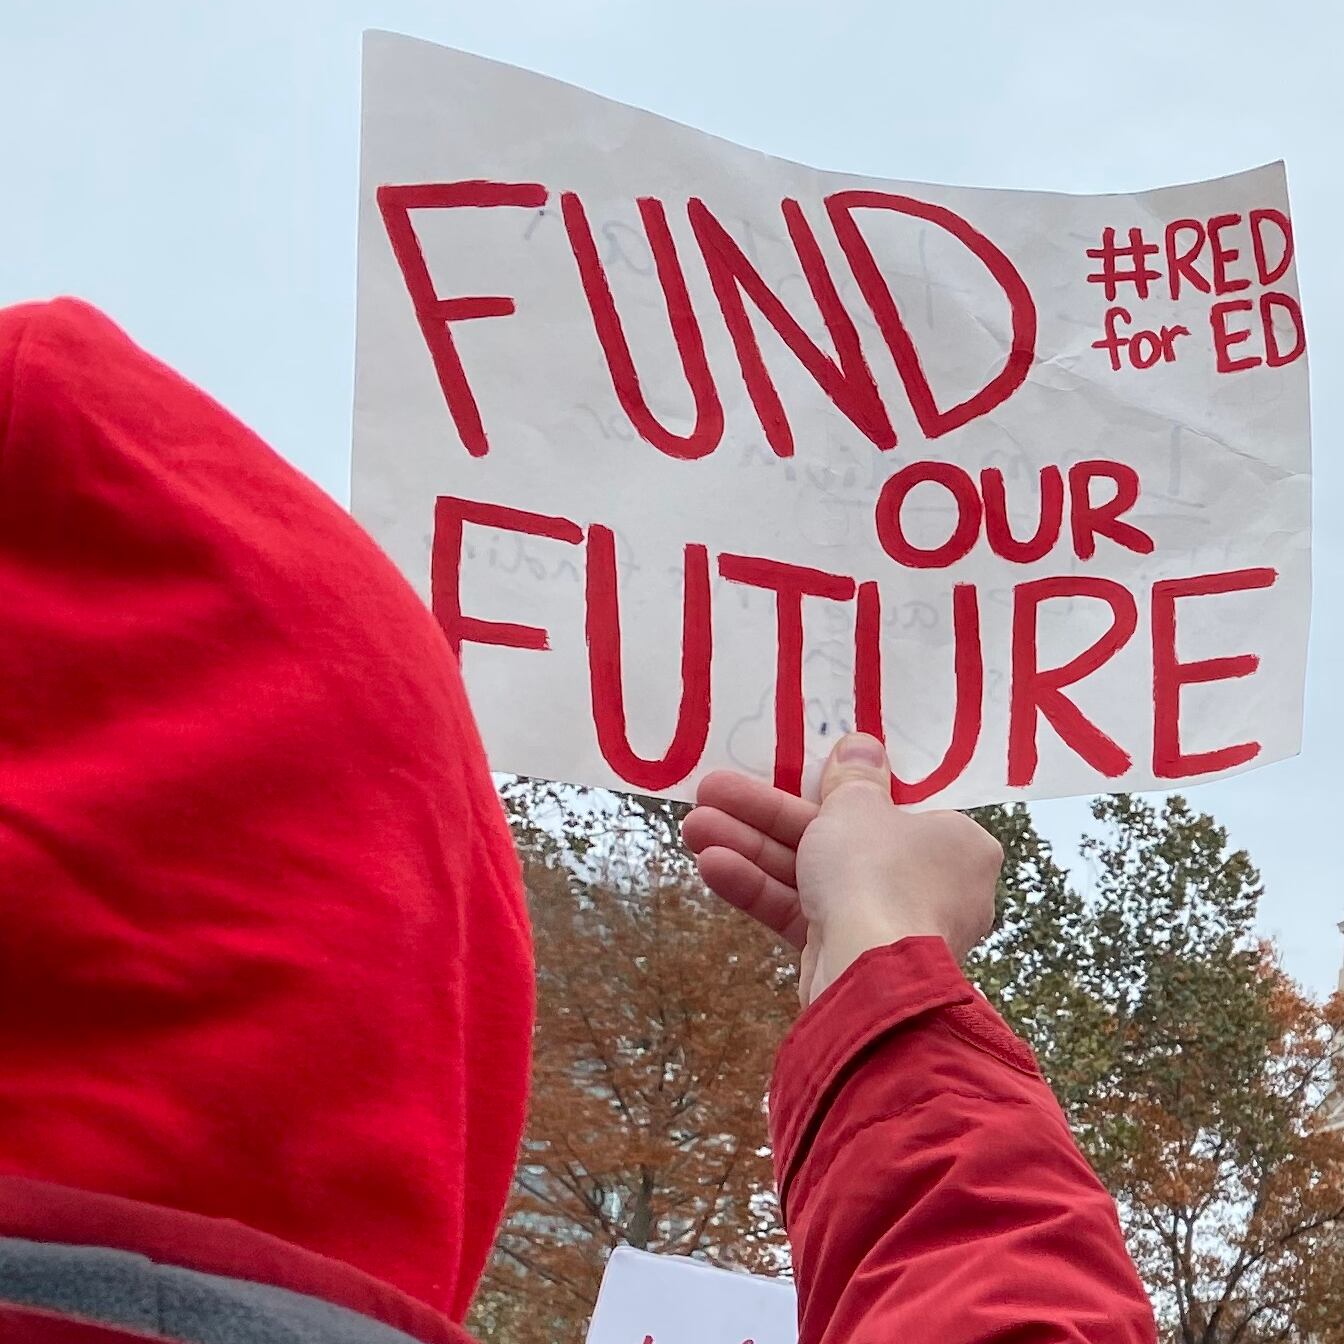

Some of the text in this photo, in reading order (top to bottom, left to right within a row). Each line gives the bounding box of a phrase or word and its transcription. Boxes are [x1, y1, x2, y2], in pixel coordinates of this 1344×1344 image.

[1087, 208, 1293, 301] #RED
[377, 180, 1037, 460] FUND
[1093, 293, 1306, 373] for ED
[876, 461, 1153, 568] OUR
[432, 495, 1278, 804] FUTURE
